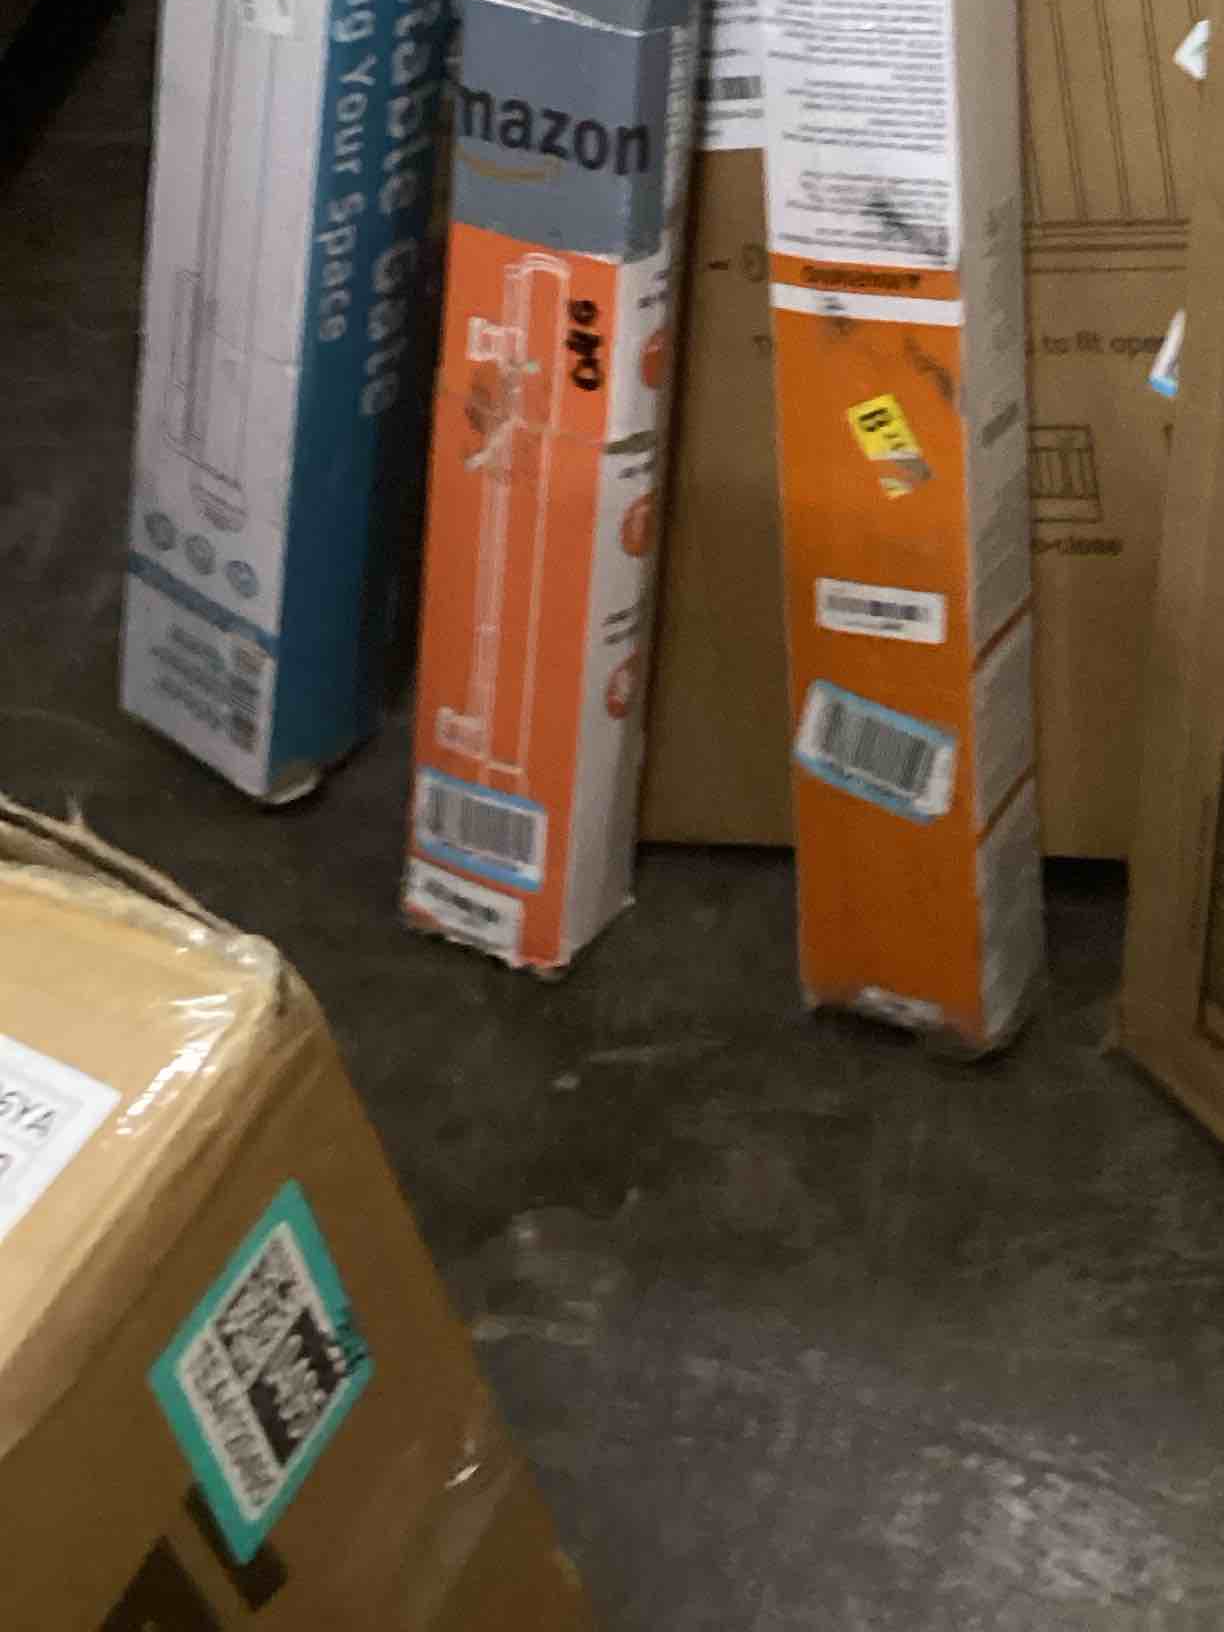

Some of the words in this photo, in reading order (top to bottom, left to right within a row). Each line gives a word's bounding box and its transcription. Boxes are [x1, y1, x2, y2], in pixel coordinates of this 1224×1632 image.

[333, 53, 377, 174] Your
[457, 81, 652, 175] mazon
[315, 191, 367, 341] Space
[361, 237, 418, 417] Gate
